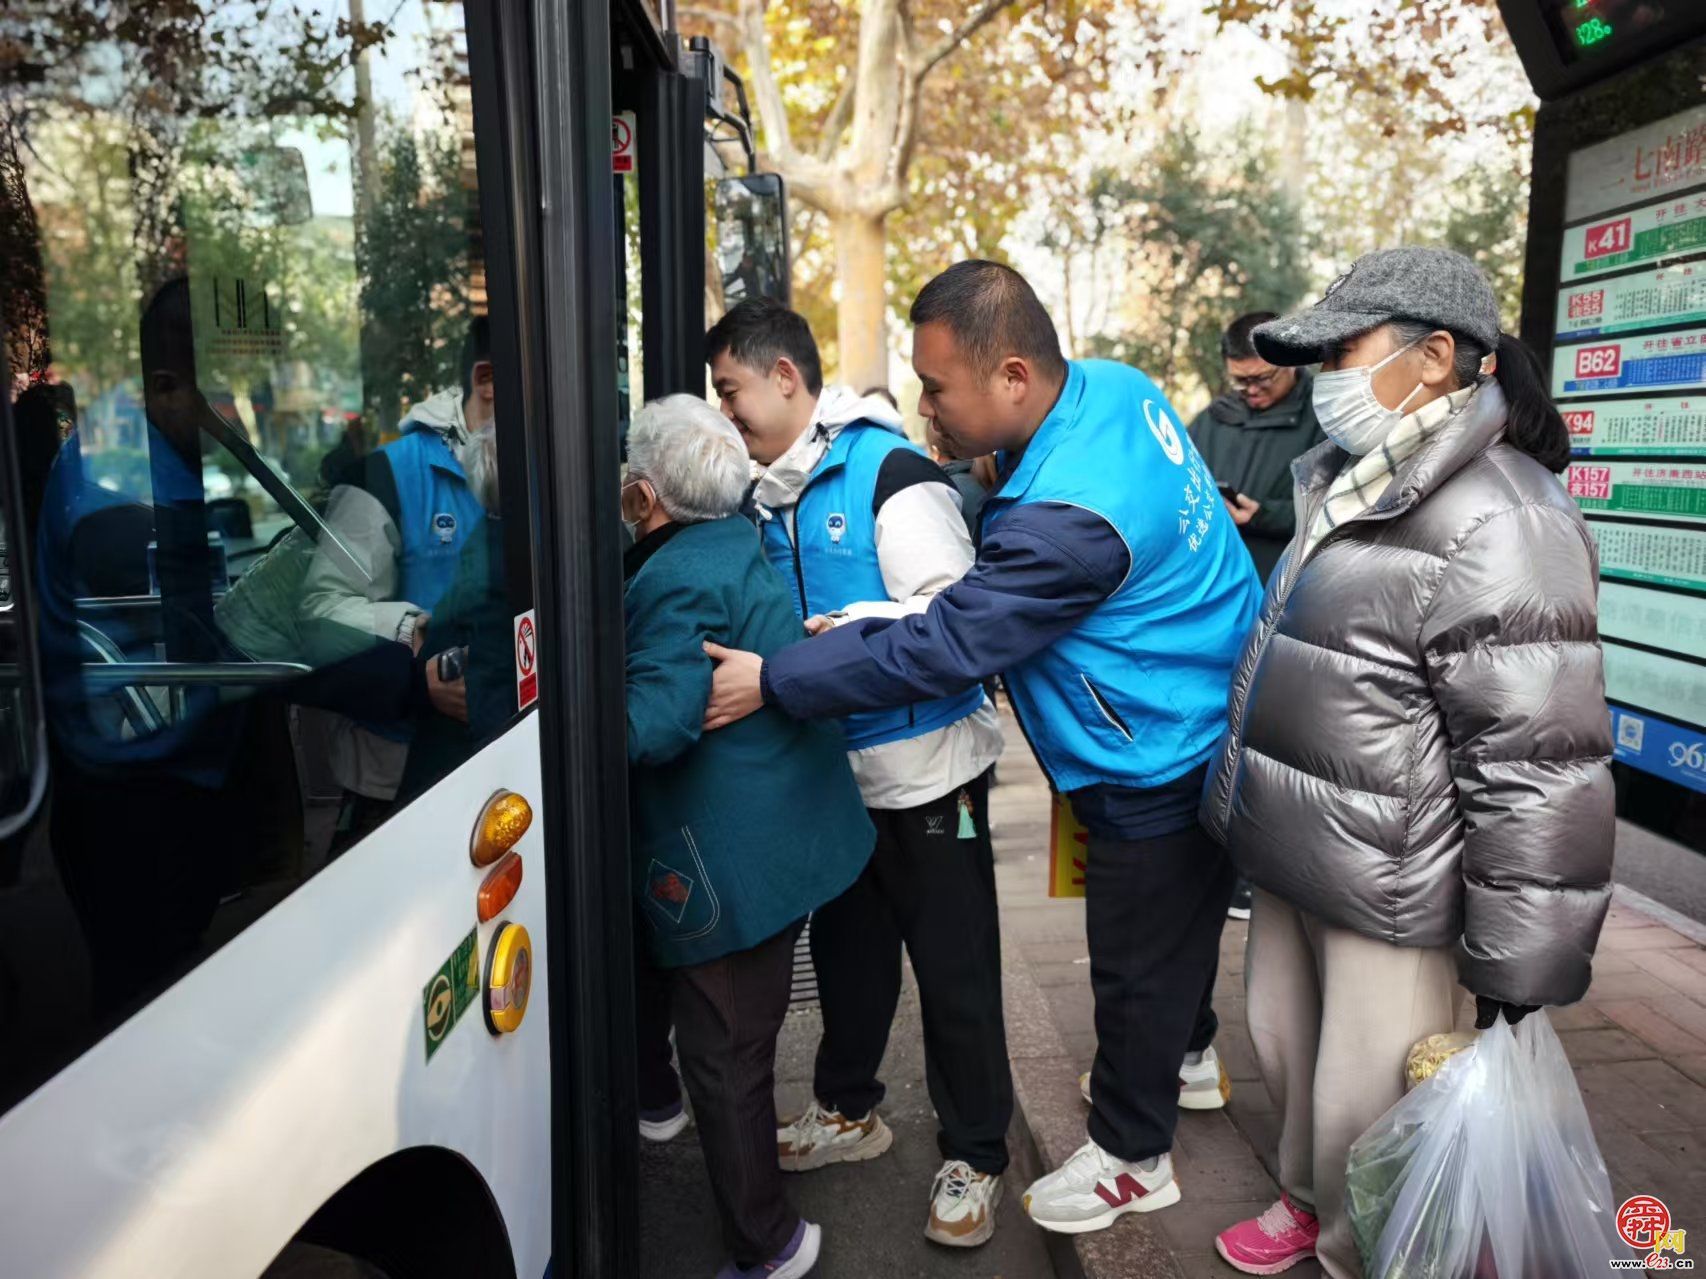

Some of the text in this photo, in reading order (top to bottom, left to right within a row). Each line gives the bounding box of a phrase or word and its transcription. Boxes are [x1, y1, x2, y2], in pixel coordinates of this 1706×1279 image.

[1588, 222, 1625, 253] K41
[1579, 349, 1616, 374] B62
[1571, 467, 1609, 482] K157
